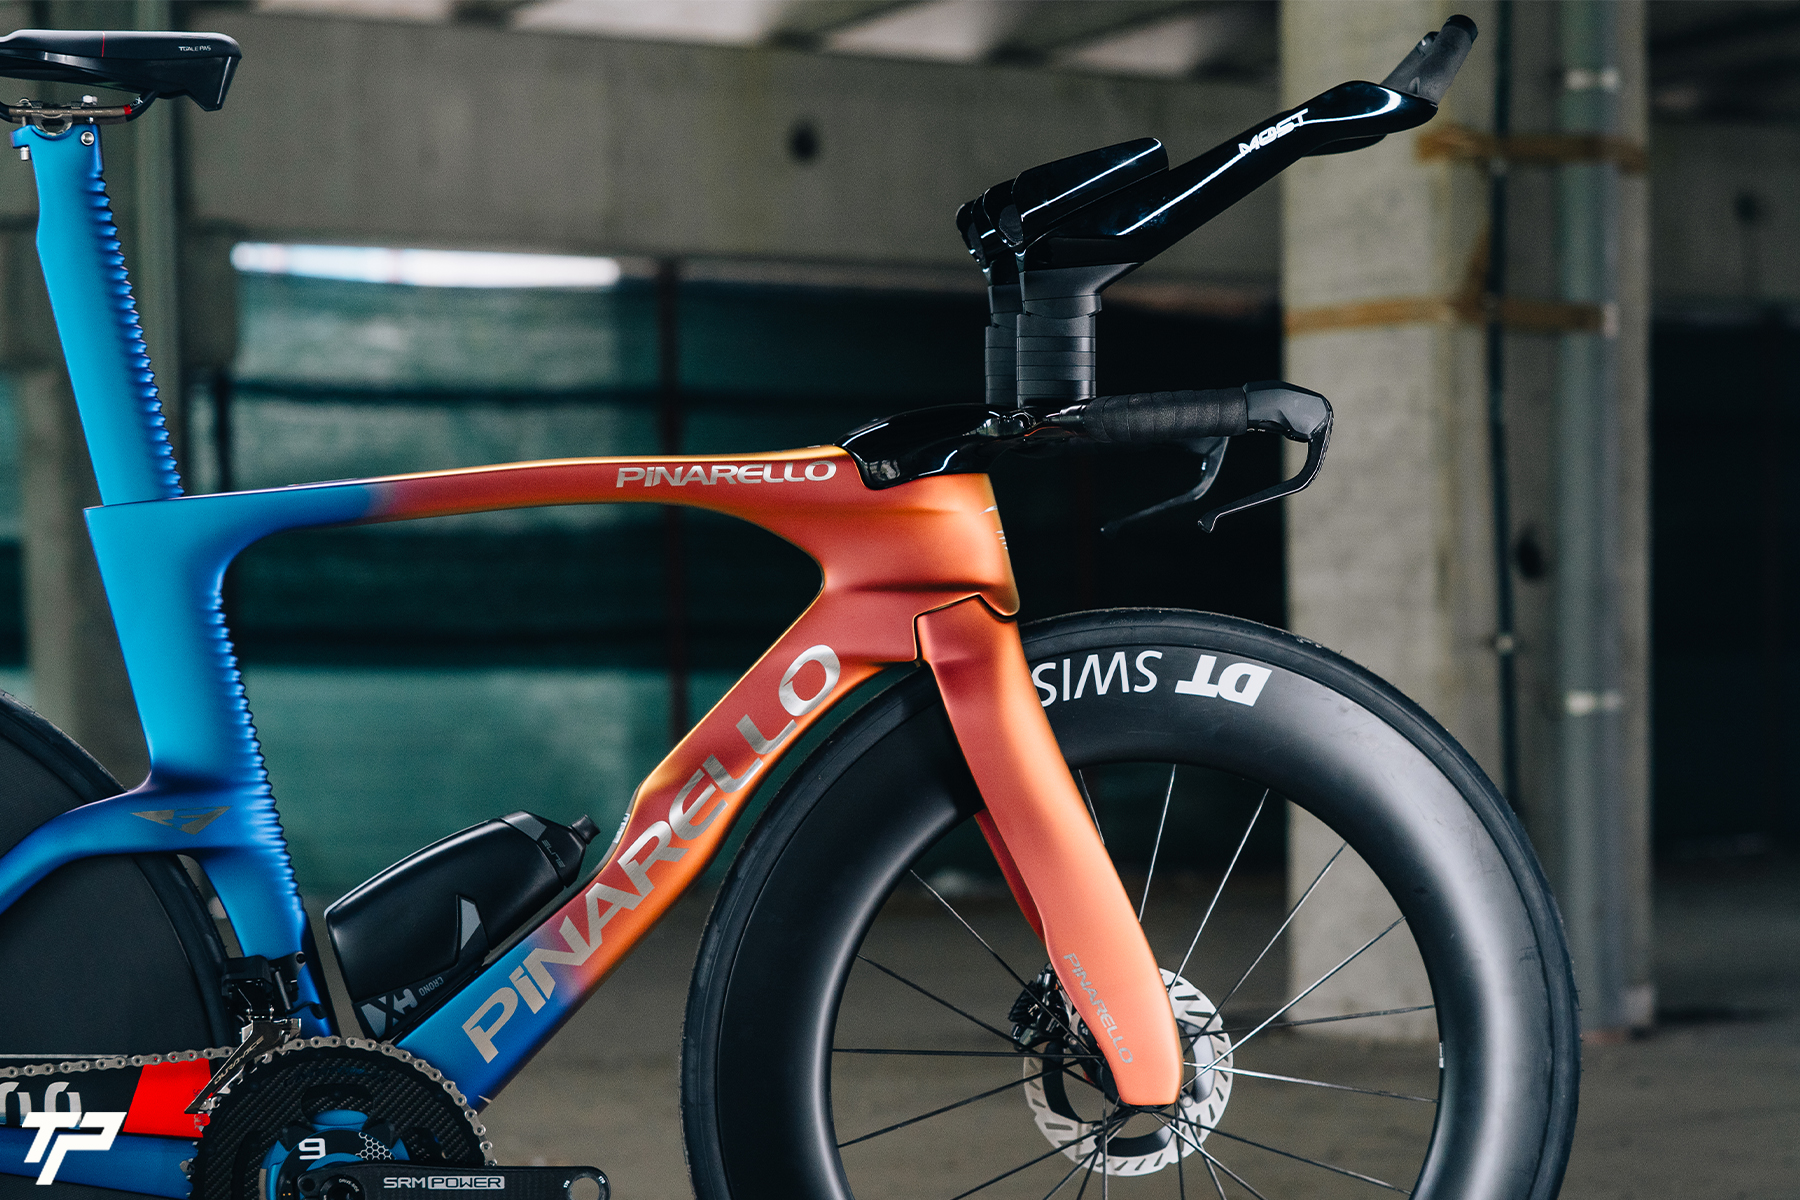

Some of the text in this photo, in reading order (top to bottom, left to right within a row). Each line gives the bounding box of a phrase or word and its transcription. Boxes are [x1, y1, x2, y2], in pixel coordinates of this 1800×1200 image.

[1238, 107, 1309, 157] MOST
[616, 460, 837, 488] PINARELLO
[1174, 654, 1272, 707] DT
[461, 644, 841, 1064] PINARELLO
[418, 976, 444, 997] CRONO
[1063, 953, 1134, 1064] PINARELLO
[298, 1137, 326, 1160] 9
[383, 1176, 504, 1189] SRM POWER
